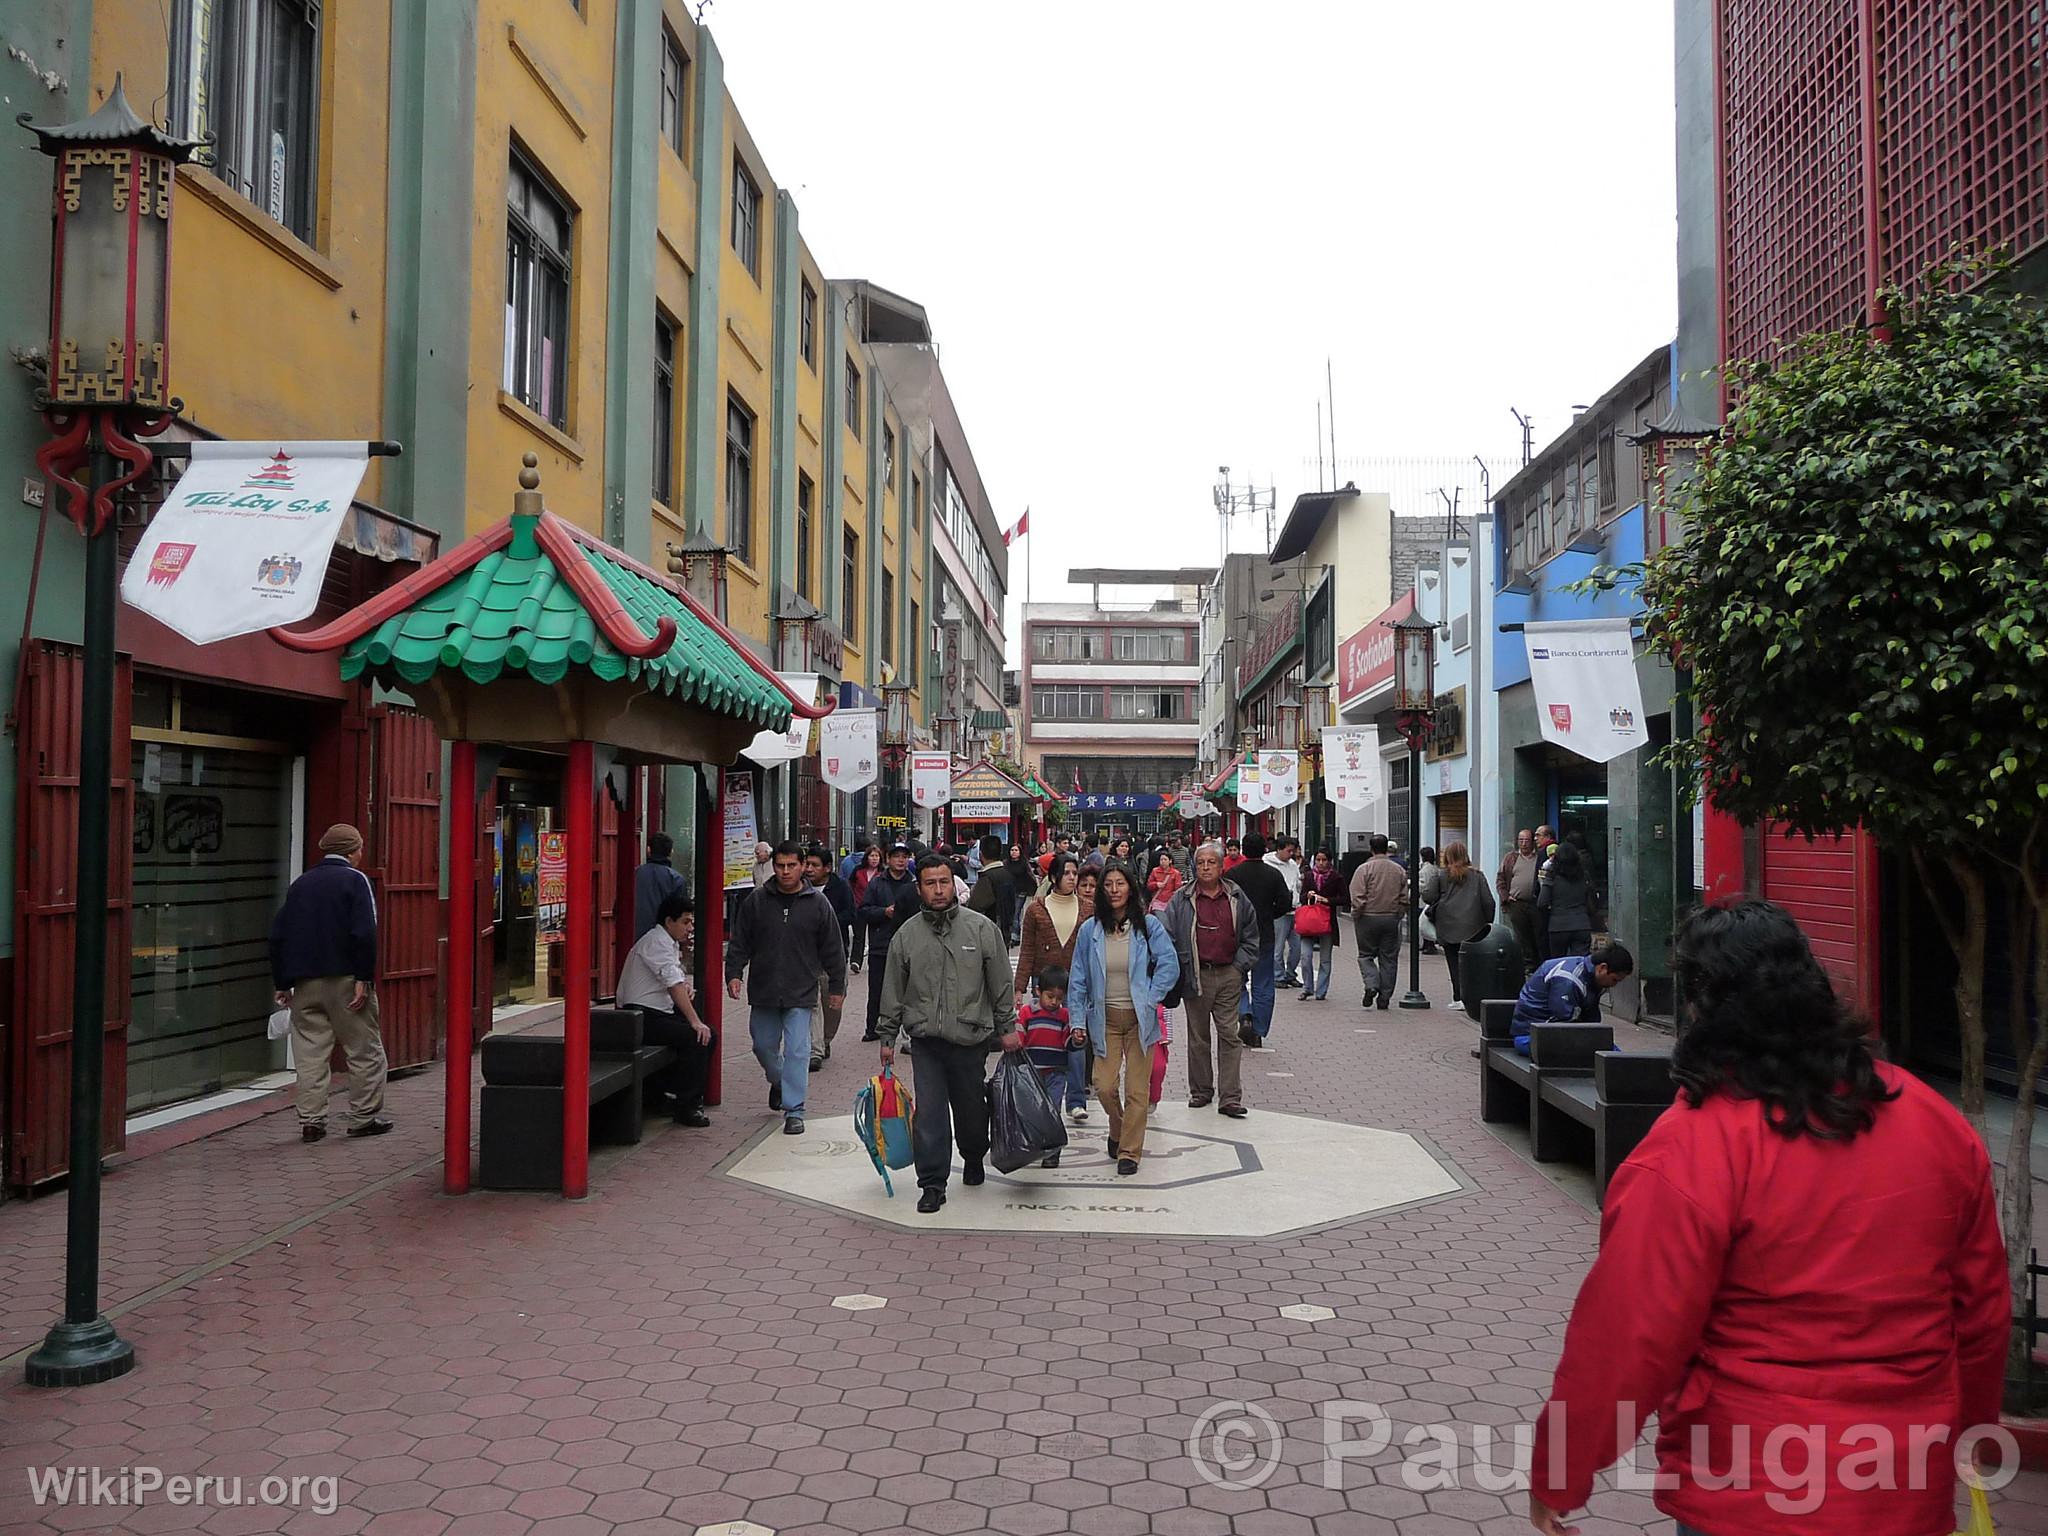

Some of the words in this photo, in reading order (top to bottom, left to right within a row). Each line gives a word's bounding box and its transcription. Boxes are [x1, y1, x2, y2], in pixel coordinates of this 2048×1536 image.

[1356, 632, 1395, 680] Scotiaban
[1578, 649, 1628, 657] Continental
[1004, 1203, 1080, 1211] INCA
[1088, 1205, 1172, 1214] KOLA
